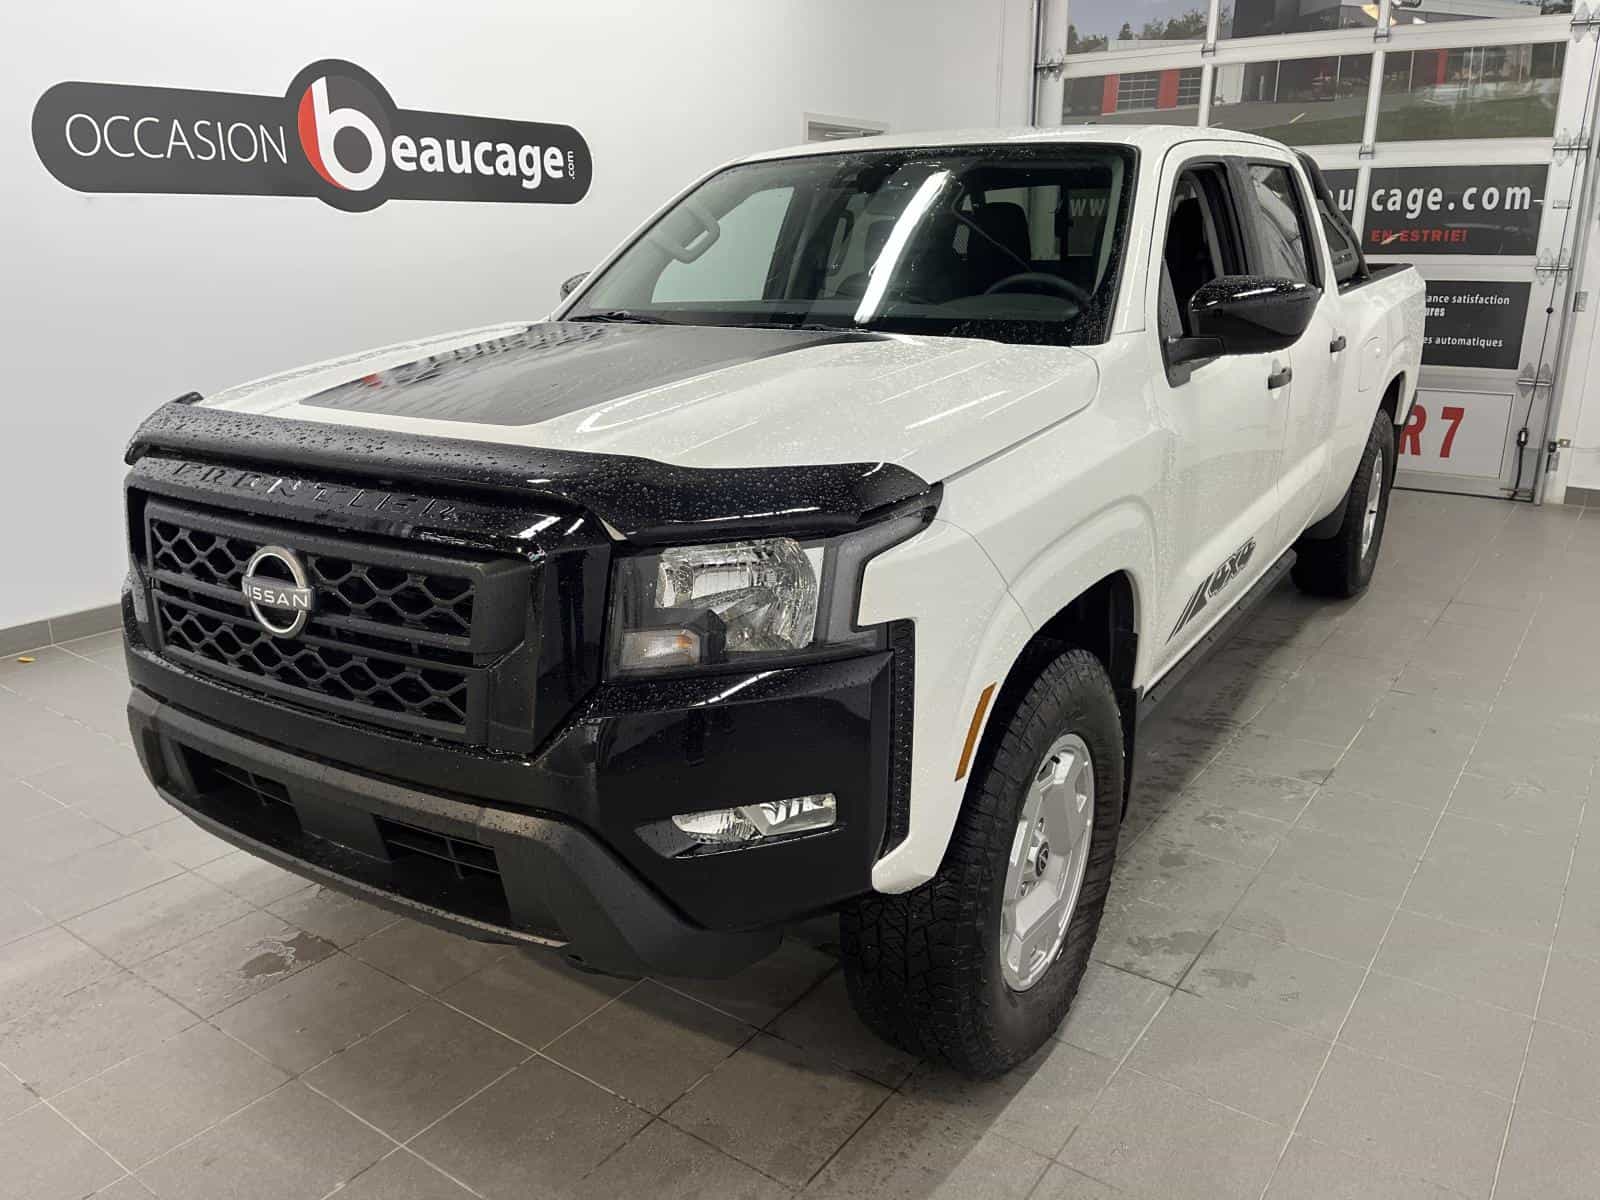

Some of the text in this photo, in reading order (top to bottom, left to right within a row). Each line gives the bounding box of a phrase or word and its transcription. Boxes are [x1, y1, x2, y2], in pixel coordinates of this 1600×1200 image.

[64, 76, 564, 191] OCCASION beaucage
[567, 150, 576, 180] .com
[1371, 229, 1468, 243] EN ESTRIE!
[1451, 293, 1511, 305] satisfaction
[1434, 336, 1504, 349] automatiques
[1439, 406, 1465, 459] 7
[243, 583, 308, 608] NISSAN
